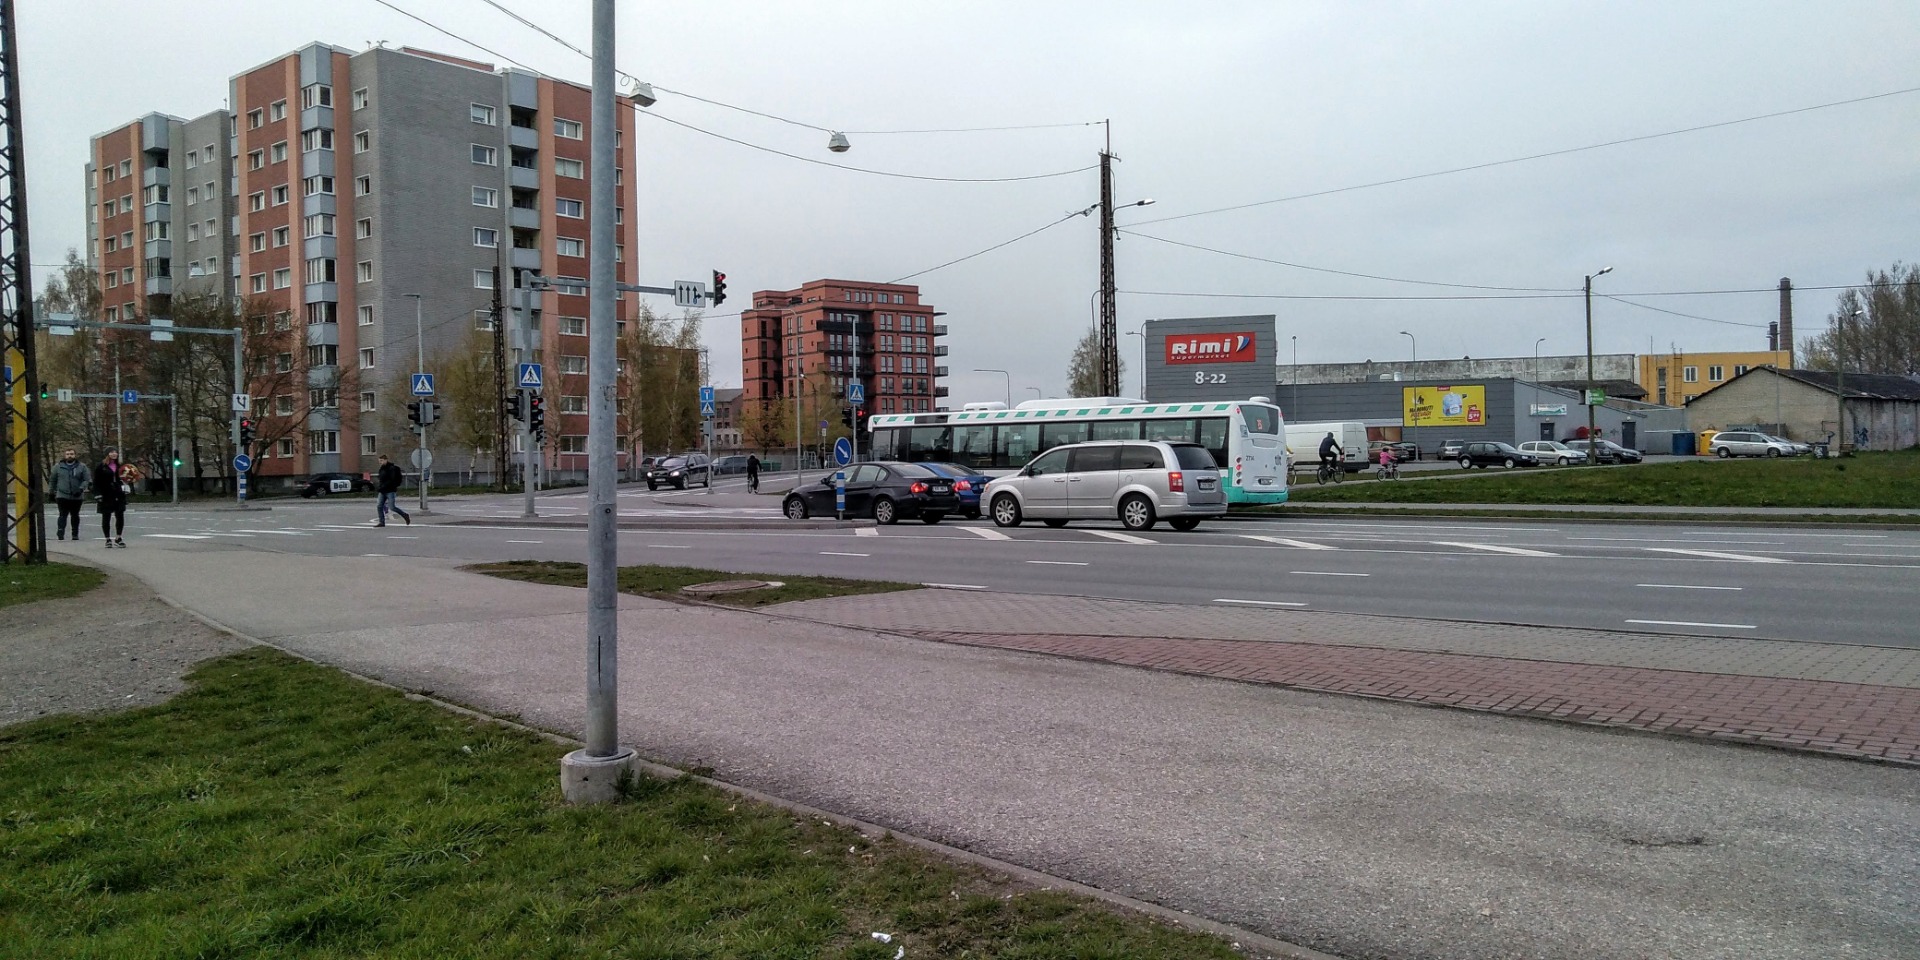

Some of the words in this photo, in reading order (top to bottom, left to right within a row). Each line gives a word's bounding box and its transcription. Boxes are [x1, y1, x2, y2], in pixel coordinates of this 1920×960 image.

[1172, 339, 1231, 354] Rimi
[1195, 371, 1226, 384] 8-22
[334, 481, 348, 489] Bolt
